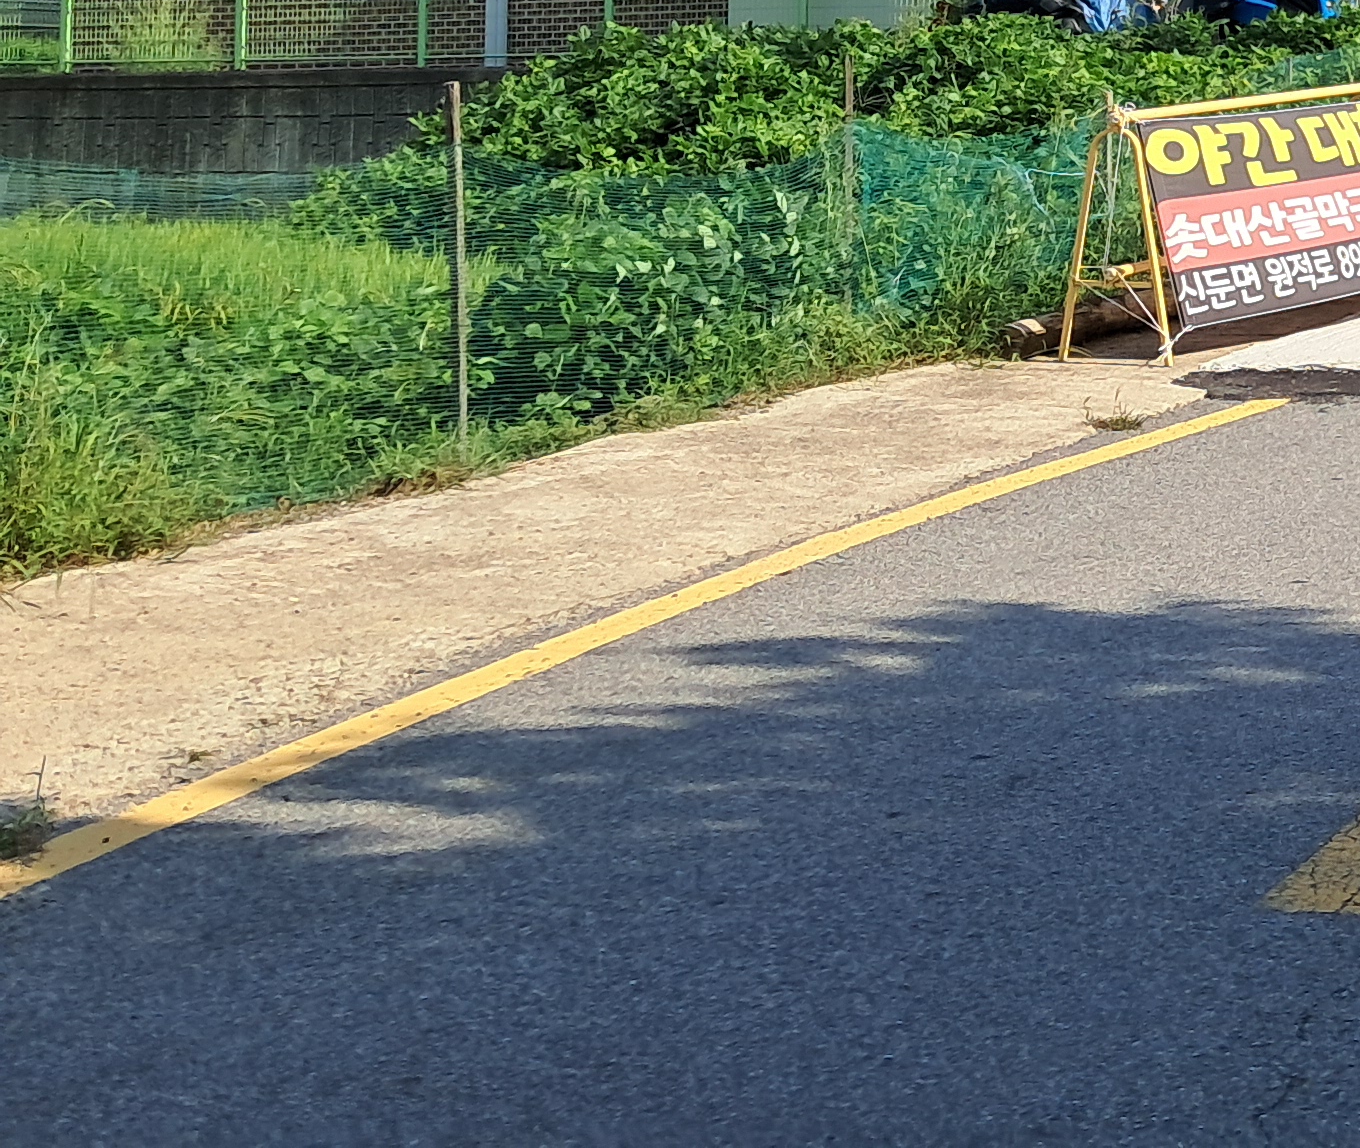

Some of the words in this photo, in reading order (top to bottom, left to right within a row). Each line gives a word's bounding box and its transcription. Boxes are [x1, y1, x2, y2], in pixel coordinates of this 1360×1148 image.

[1145, 117, 1297, 187] 야간
[1178, 262, 1265, 315] 신둔면
[1264, 248, 1339, 298] 원적로
